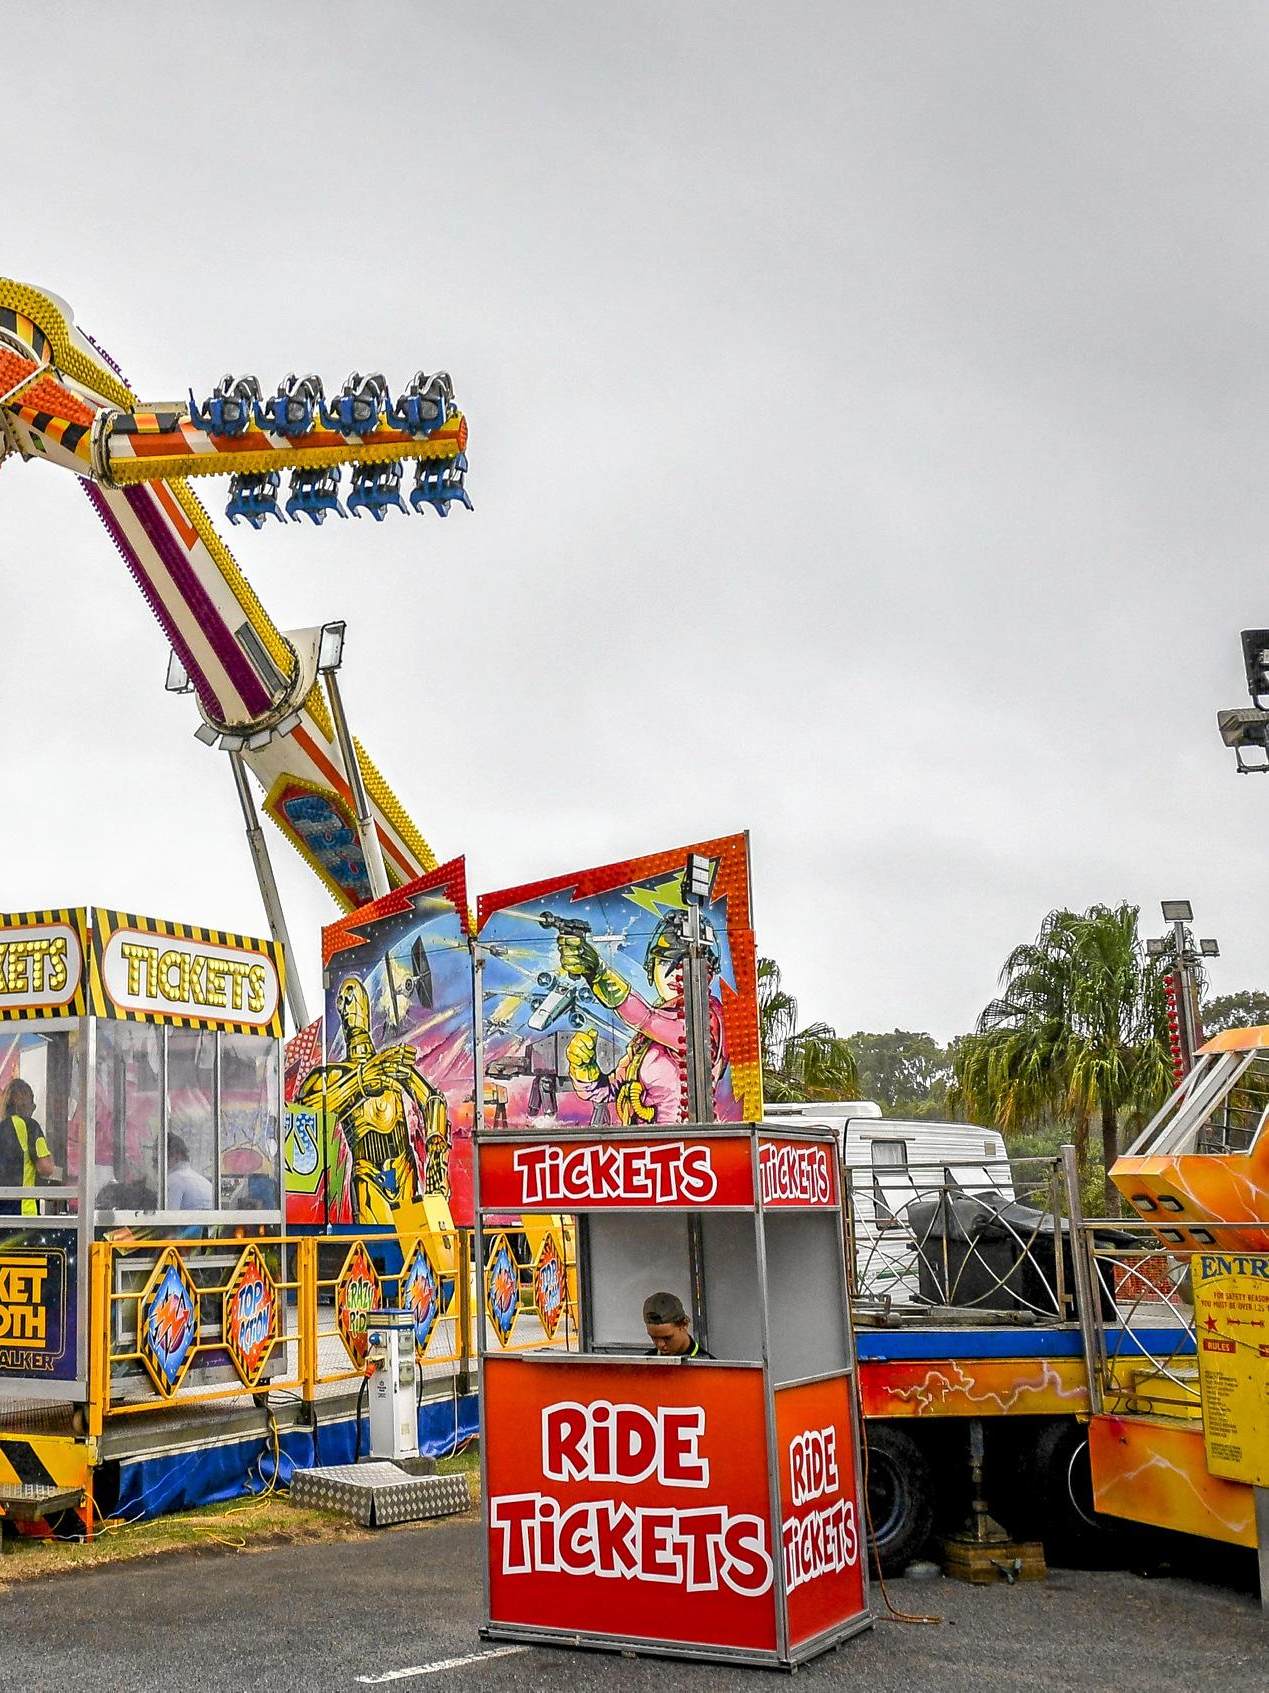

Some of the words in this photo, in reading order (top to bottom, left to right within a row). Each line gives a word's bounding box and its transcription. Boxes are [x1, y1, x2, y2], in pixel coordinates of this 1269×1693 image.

[121, 942, 265, 1013] TICKETS
[237, 1280, 264, 1320] TOP
[346, 1275, 374, 1311] CRAZY
[1238, 1303, 1253, 1311] OVER
[1207, 1341, 1230, 1352] RULES
